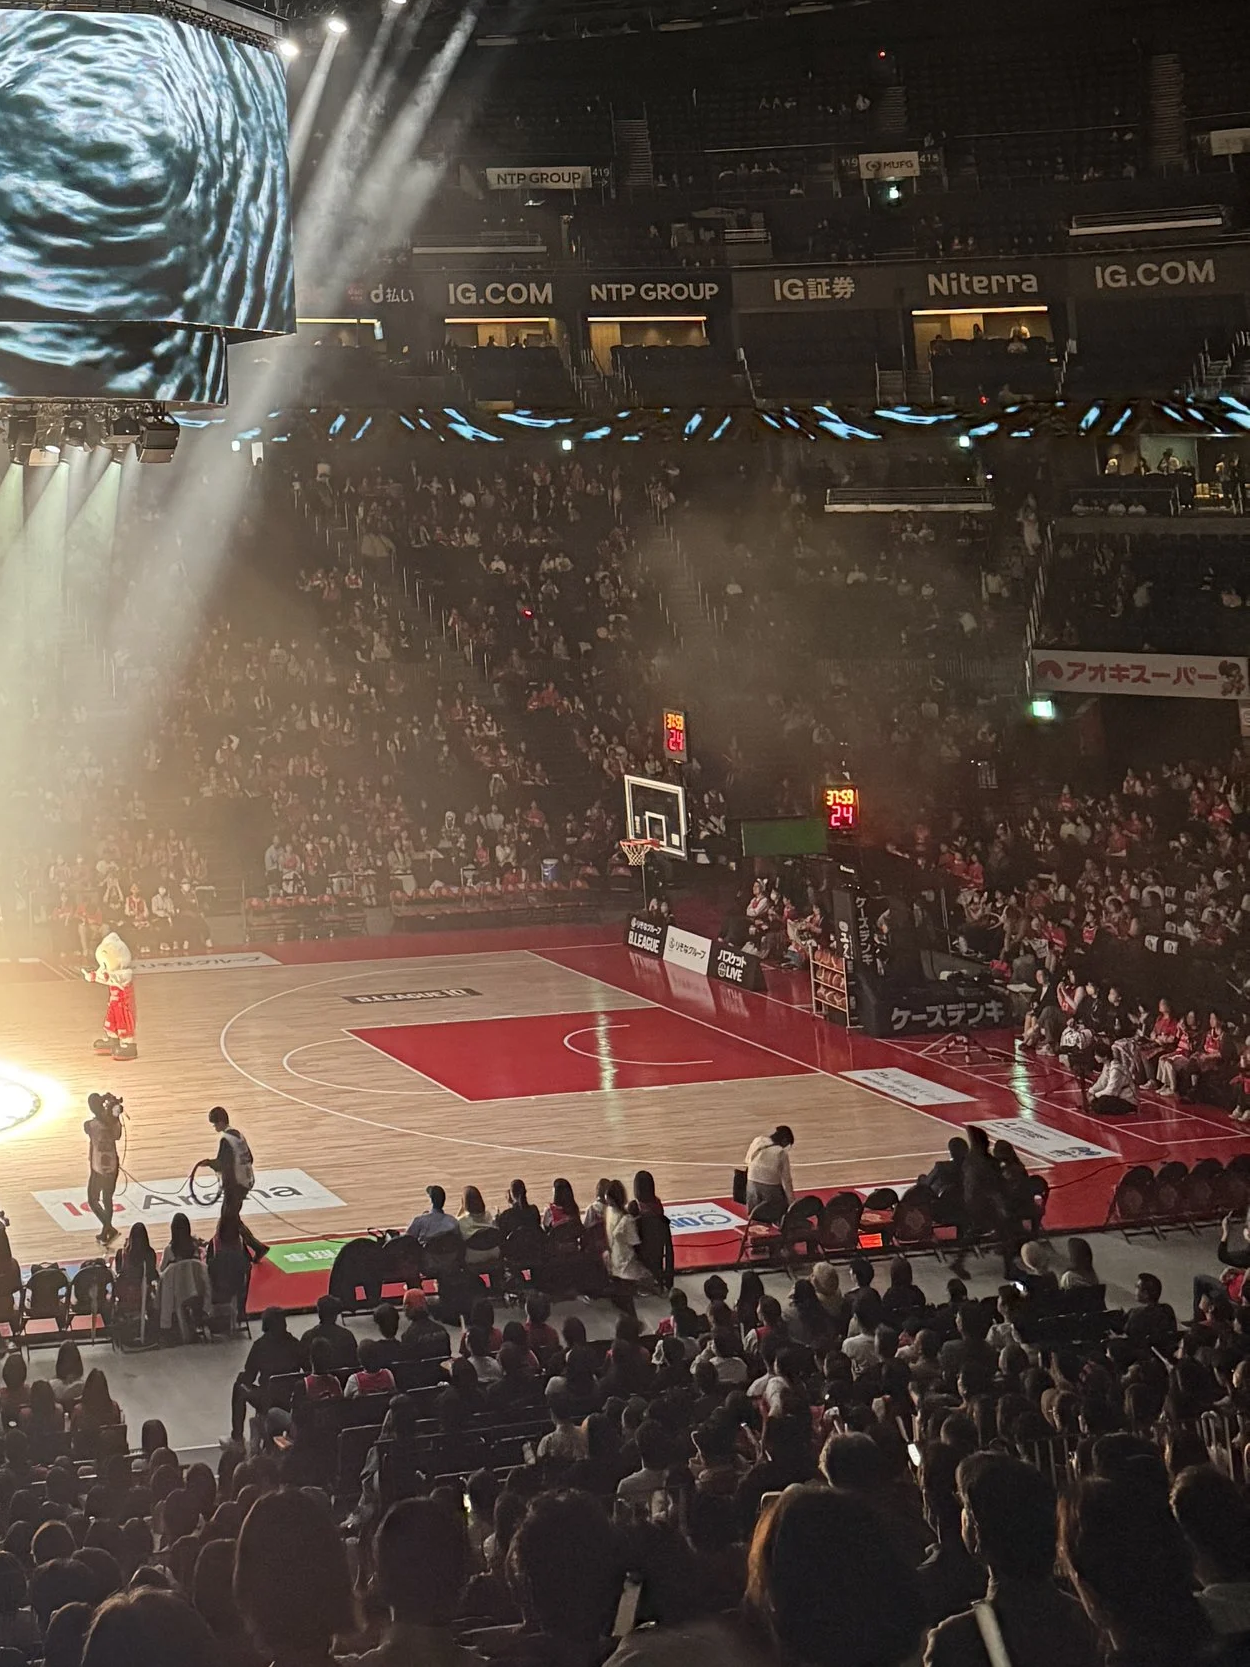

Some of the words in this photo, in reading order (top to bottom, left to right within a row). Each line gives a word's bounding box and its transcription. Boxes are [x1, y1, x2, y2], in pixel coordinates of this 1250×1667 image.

[883, 159, 914, 170] MUFG
[497, 173, 526, 185] NTP
[529, 172, 581, 184] GROUP
[927, 271, 1039, 297] Niterra
[1095, 258, 1217, 289] IG.COM
[448, 282, 553, 305] IG.COM
[591, 284, 636, 301] NTP
[639, 283, 719, 301] GROUP
[774, 276, 856, 302] IG証券
[1066, 661, 1218, 685] アオキスーパー
[669, 729, 684, 751] 24
[826, 789, 855, 806] 37:59
[831, 805, 853, 826] 24
[855, 896, 874, 966] ケーズデンキ
[675, 941, 707, 960] りそなグループ
[726, 966, 744, 982] LIVE
[891, 999, 1005, 1031] ケーズデンキ
